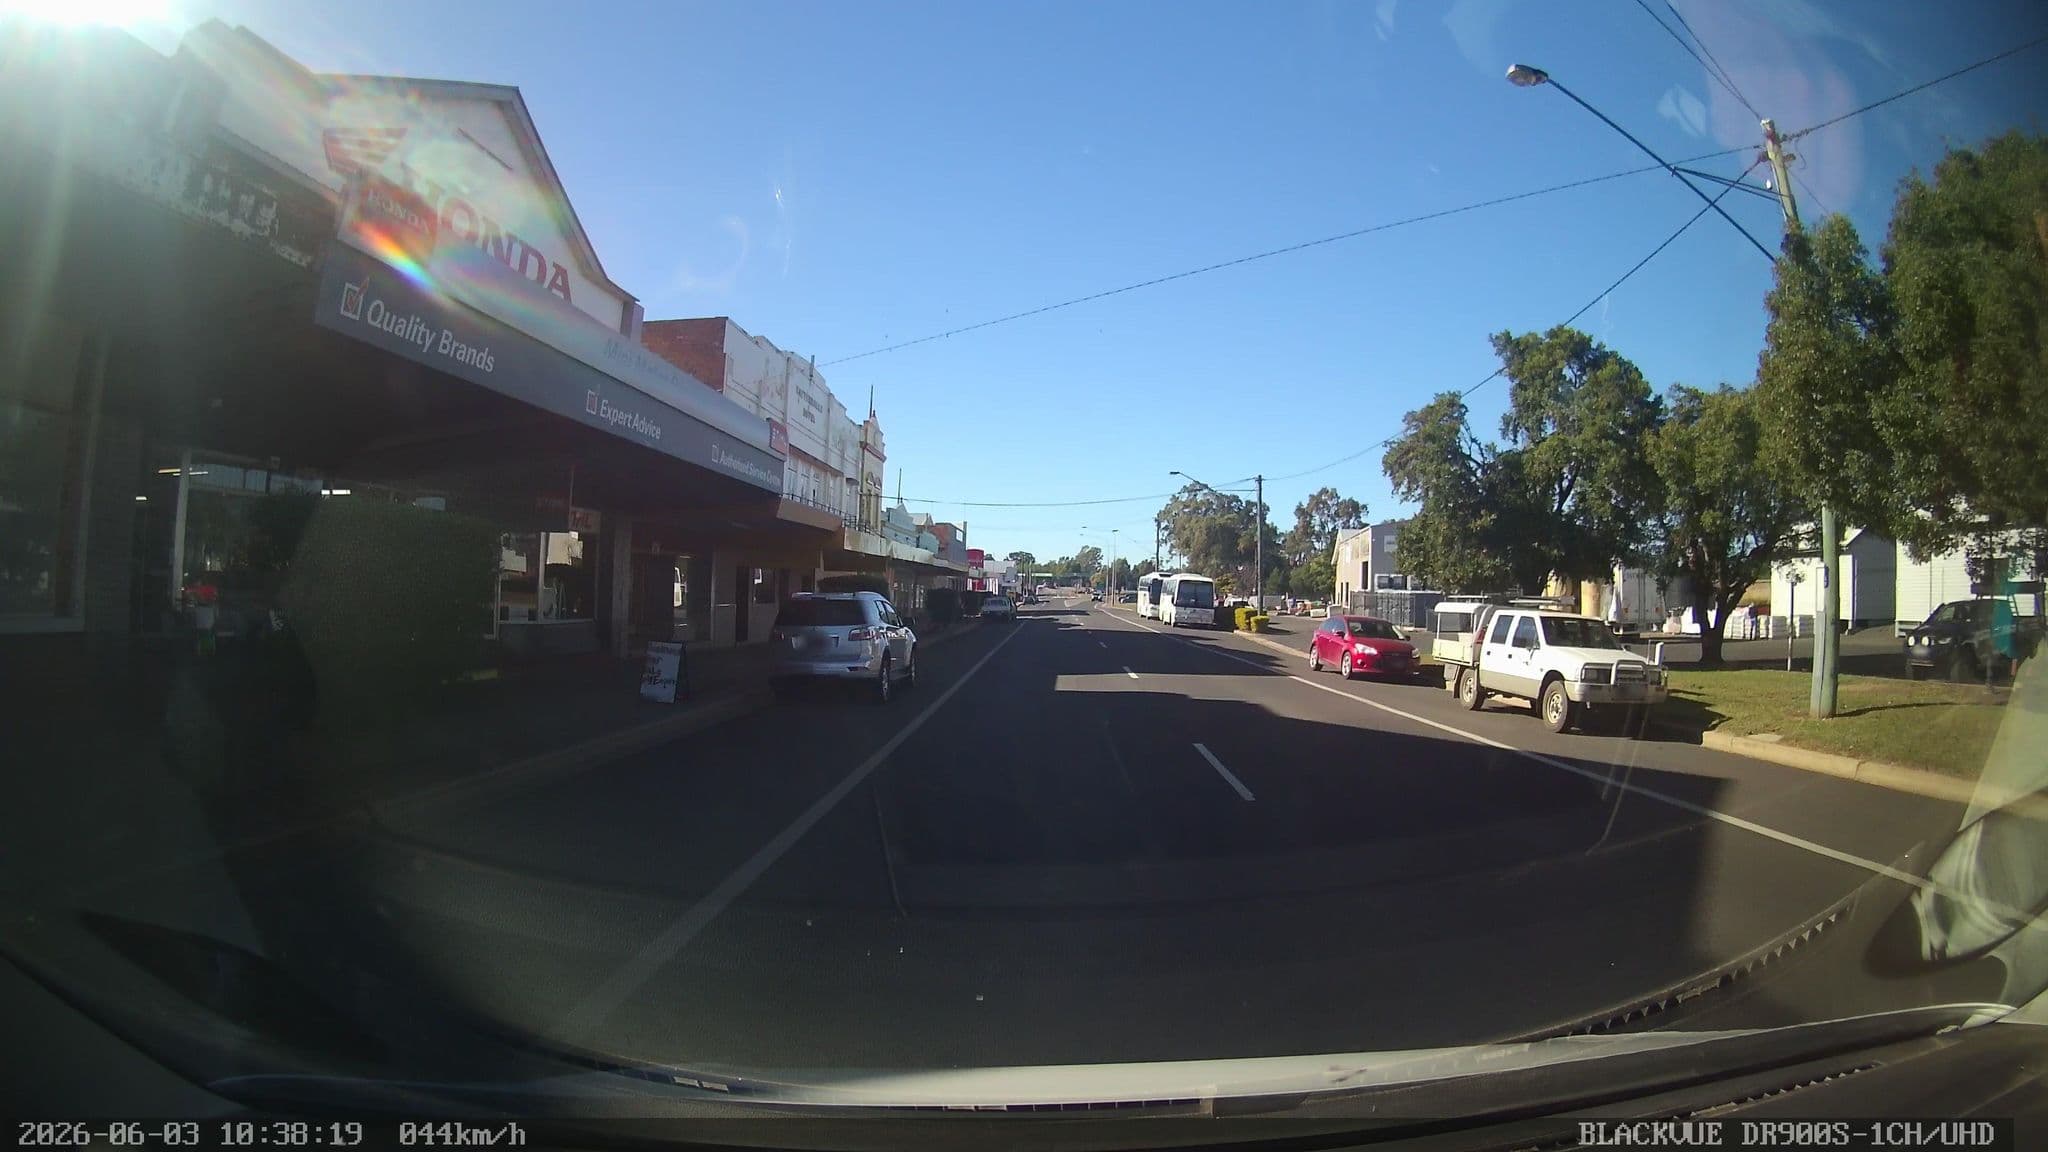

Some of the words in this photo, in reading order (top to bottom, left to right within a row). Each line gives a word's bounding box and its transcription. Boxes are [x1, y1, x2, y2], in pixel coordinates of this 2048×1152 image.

[367, 299, 437, 353] Quality
[438, 328, 496, 373] Brands
[600, 400, 633, 427] Expert
[632, 415, 662, 440] Advice
